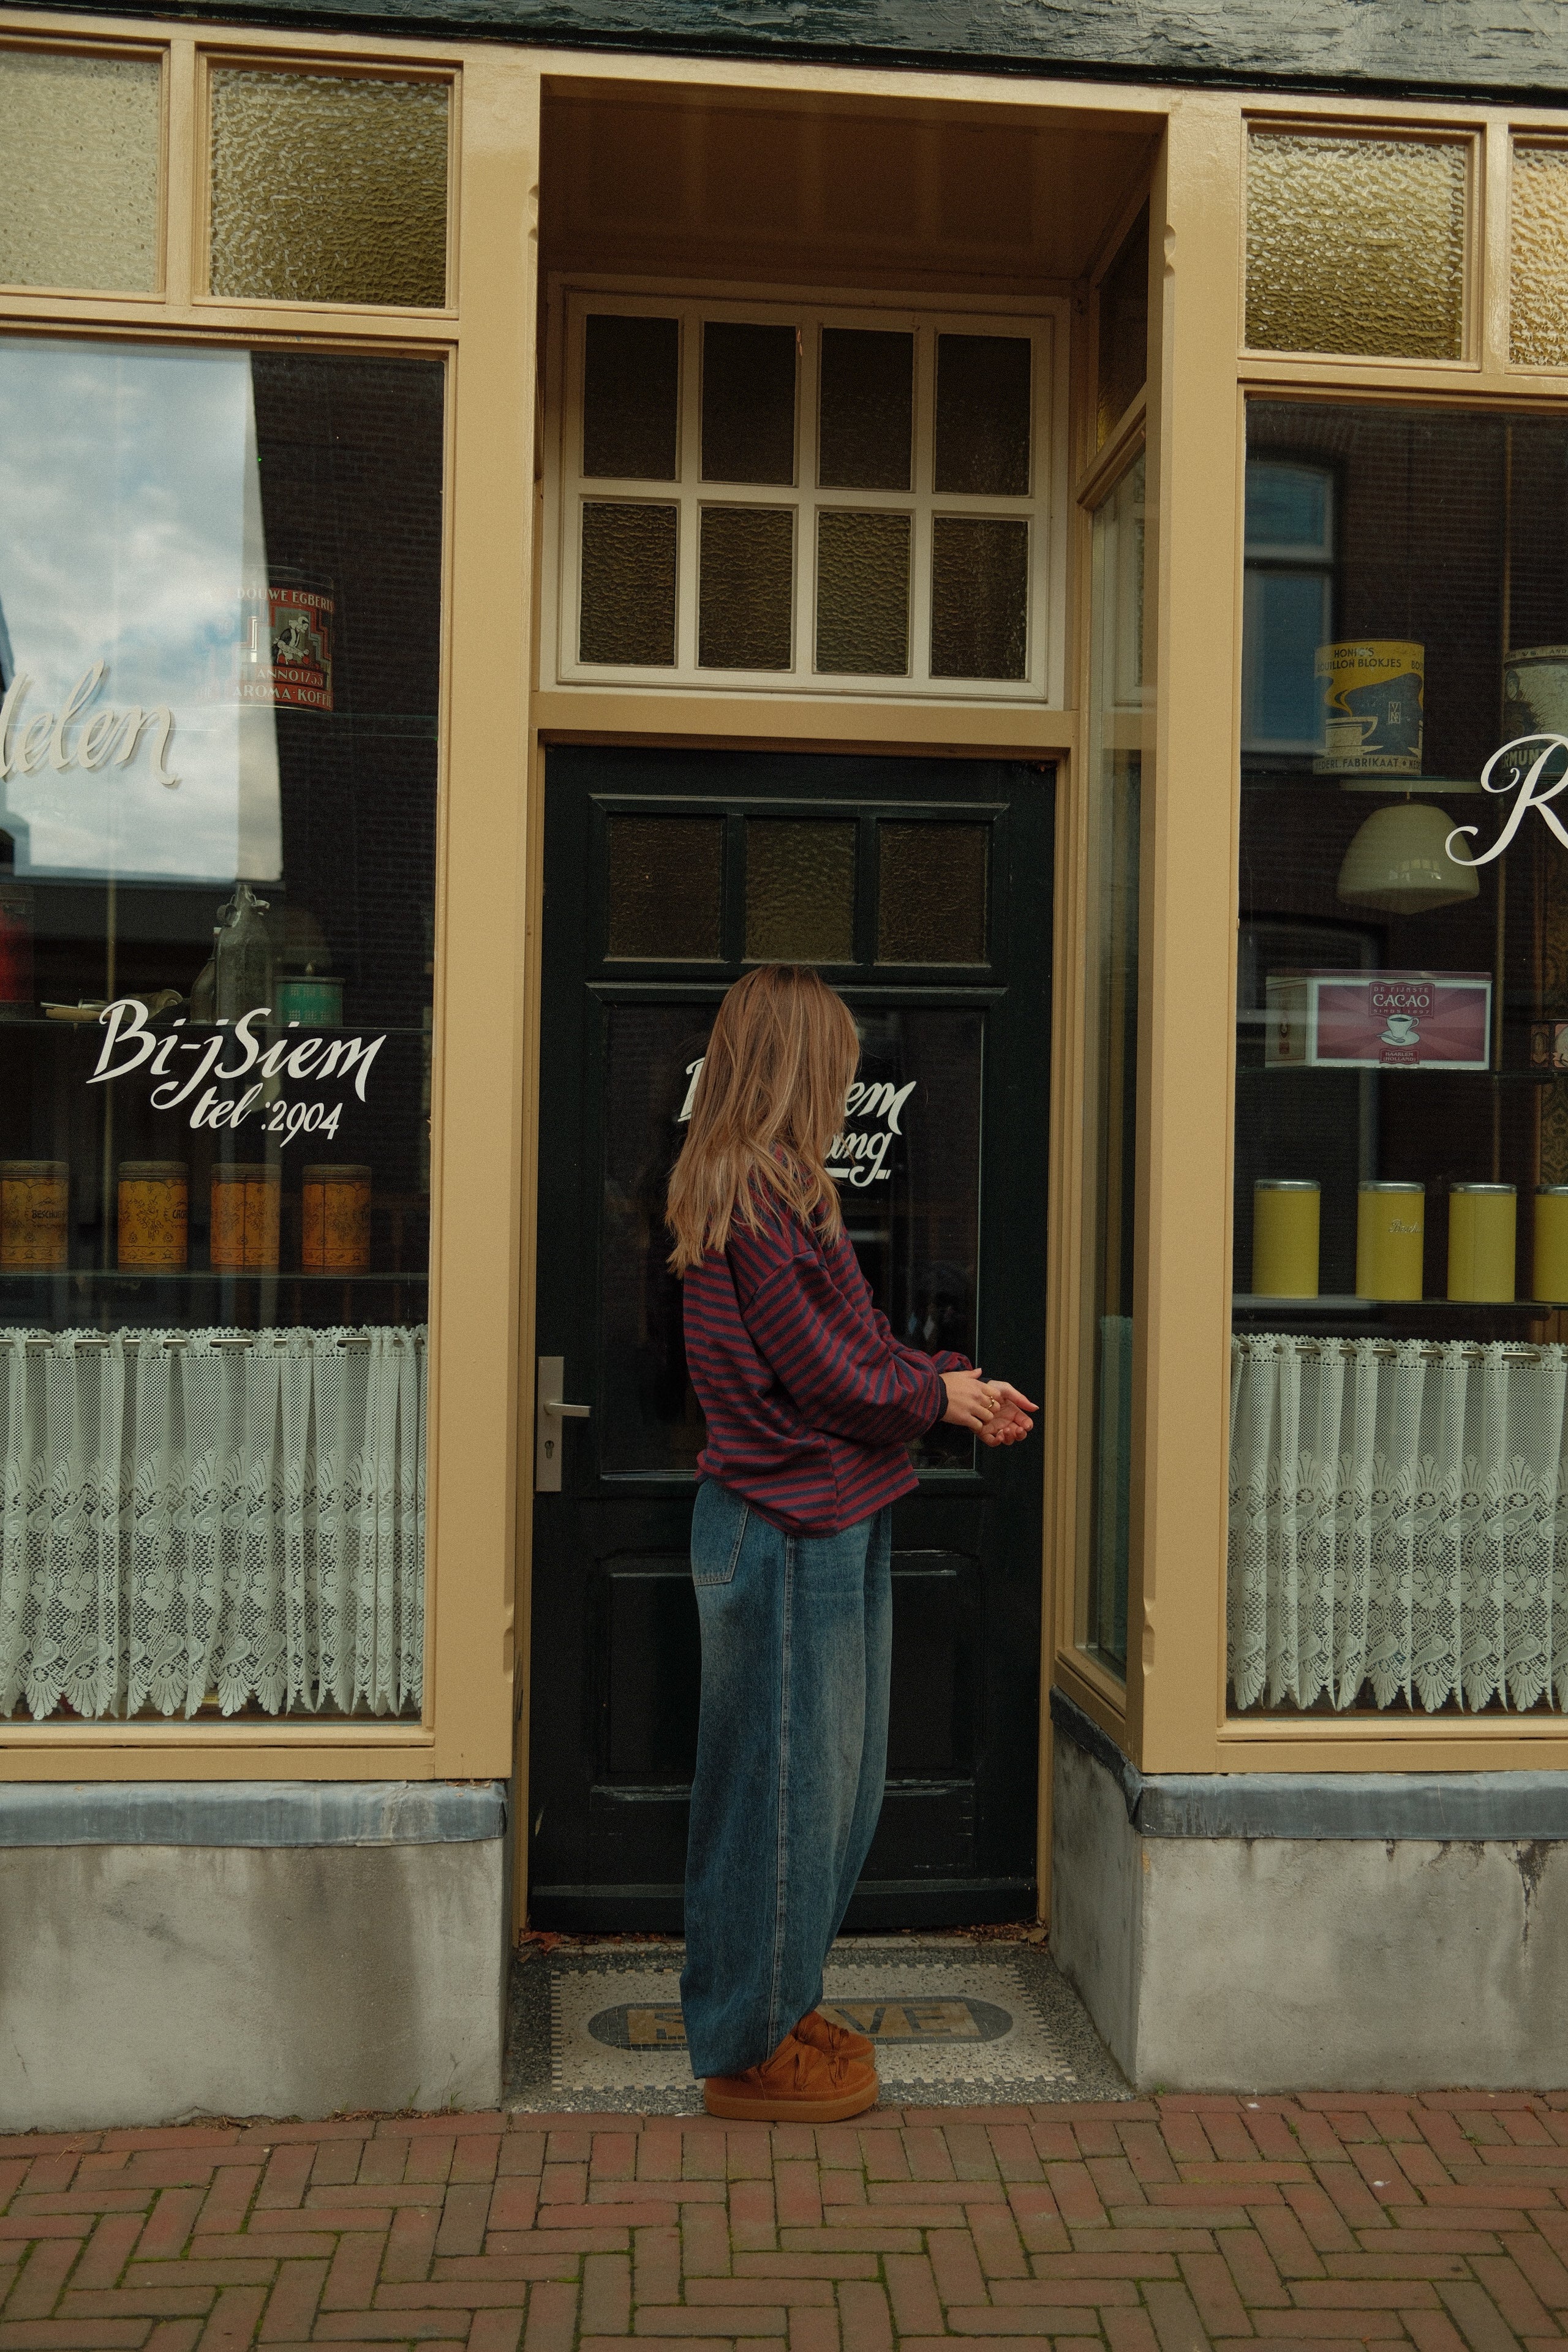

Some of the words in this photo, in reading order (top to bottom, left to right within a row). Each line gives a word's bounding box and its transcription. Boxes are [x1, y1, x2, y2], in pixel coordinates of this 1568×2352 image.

[237, 588, 288, 602] DOUWE
[292, 590, 334, 612] EGBERTS
[1358, 658, 1401, 668] BLOKJES
[258, 668, 299, 682] ANNO
[233, 684, 333, 708] AROMA-KOFFIE
[1343, 758, 1399, 767] FABRIKAAT
[1373, 994, 1430, 1008] CACAO
[189, 1082, 263, 1129] tel
